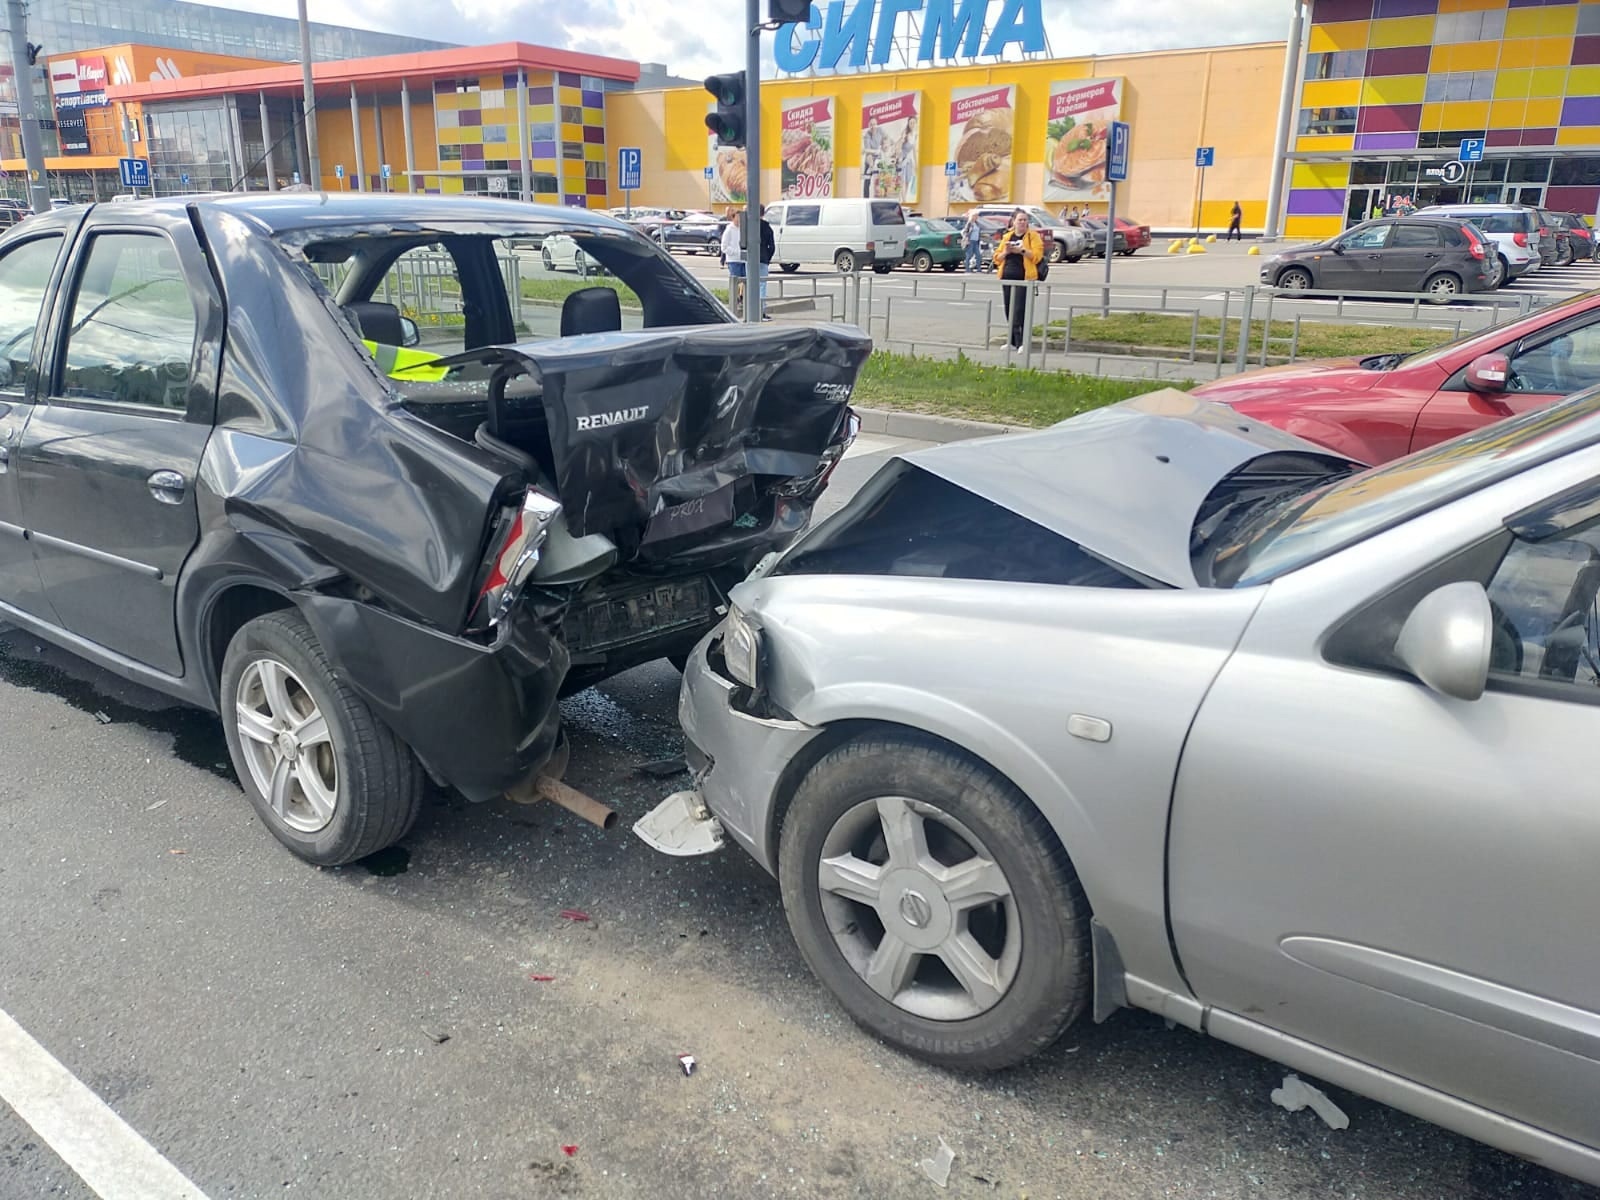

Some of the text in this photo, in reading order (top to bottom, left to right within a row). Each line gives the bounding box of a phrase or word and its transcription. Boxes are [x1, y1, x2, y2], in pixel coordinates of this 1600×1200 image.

[773, 0, 1044, 72] СИГМА
[957, 94, 999, 111] Собственная
[1056, 87, 1105, 105] От фермеров
[787, 106, 814, 121] Скидка
[869, 99, 902, 117] Семейный
[1056, 101, 1088, 115] Карелии
[57, 119, 84, 128] RESERVED
[1115, 127, 1123, 154] P
[1466, 140, 1478, 151] P
[629, 151, 638, 171] P
[1200, 149, 1209, 158] P
[133, 161, 143, 175] P
[1448, 165, 1457, 179] 1
[789, 173, 831, 198] -30%
[576, 405, 649, 431] RENAULT
